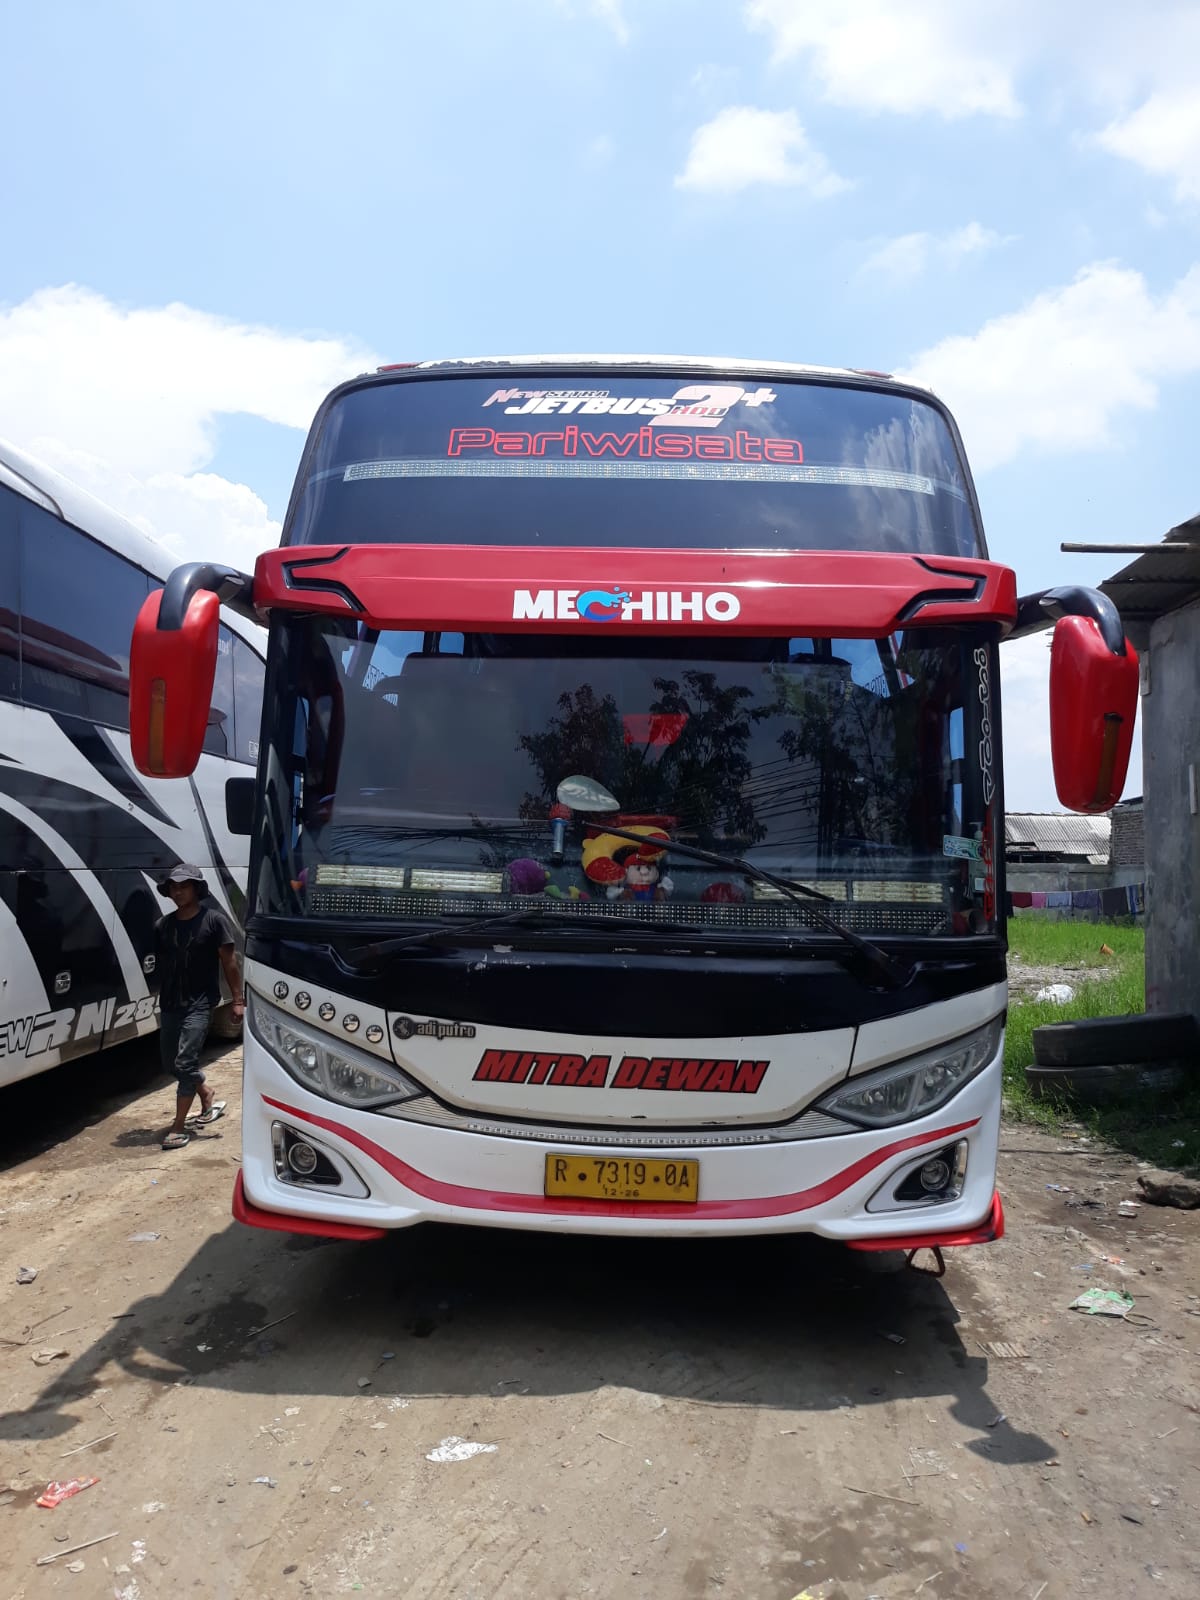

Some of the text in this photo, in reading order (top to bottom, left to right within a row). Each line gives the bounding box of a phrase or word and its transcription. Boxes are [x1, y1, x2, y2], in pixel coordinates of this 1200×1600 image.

[503, 397, 677, 415] JETBUS
[447, 425, 803, 463] Pariwisata
[512, 586, 741, 622] MECHIHO
[472, 1048, 770, 1094] MITRA DEWAN
[593, 1161, 646, 1185] 7319
